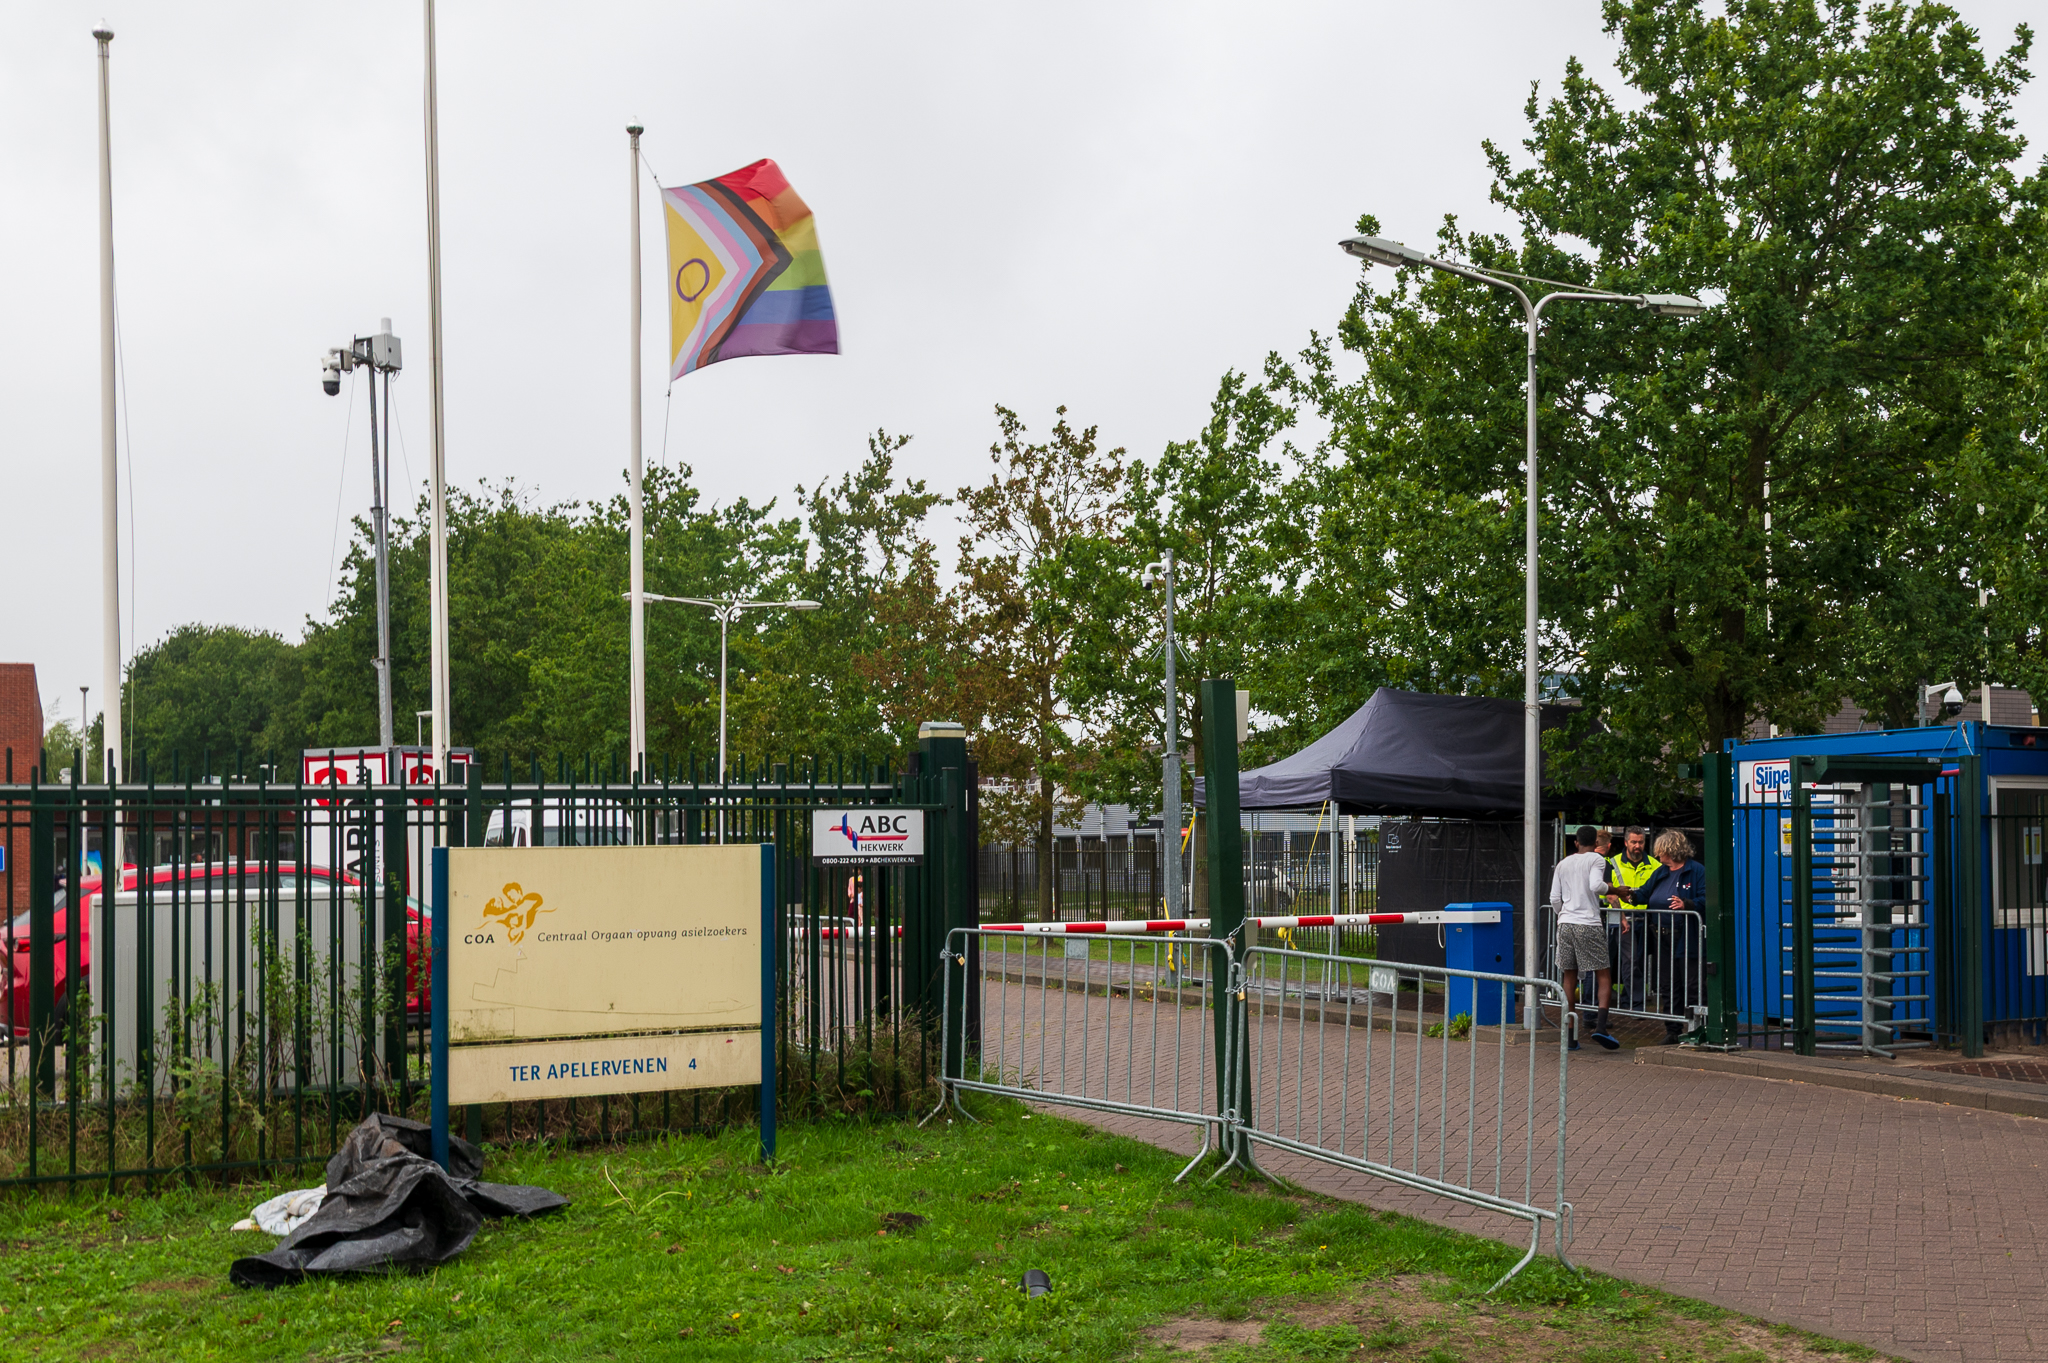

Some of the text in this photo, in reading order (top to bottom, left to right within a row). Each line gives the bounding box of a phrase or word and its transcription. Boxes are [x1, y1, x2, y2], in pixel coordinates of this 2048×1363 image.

[860, 815, 907, 834] ABC
[860, 843, 904, 852] HEKWERK
[464, 926, 747, 944] COA Centraal Orgaan opvang asielzoekers
[510, 1057, 697, 1082] TER APELERVENEN 4
